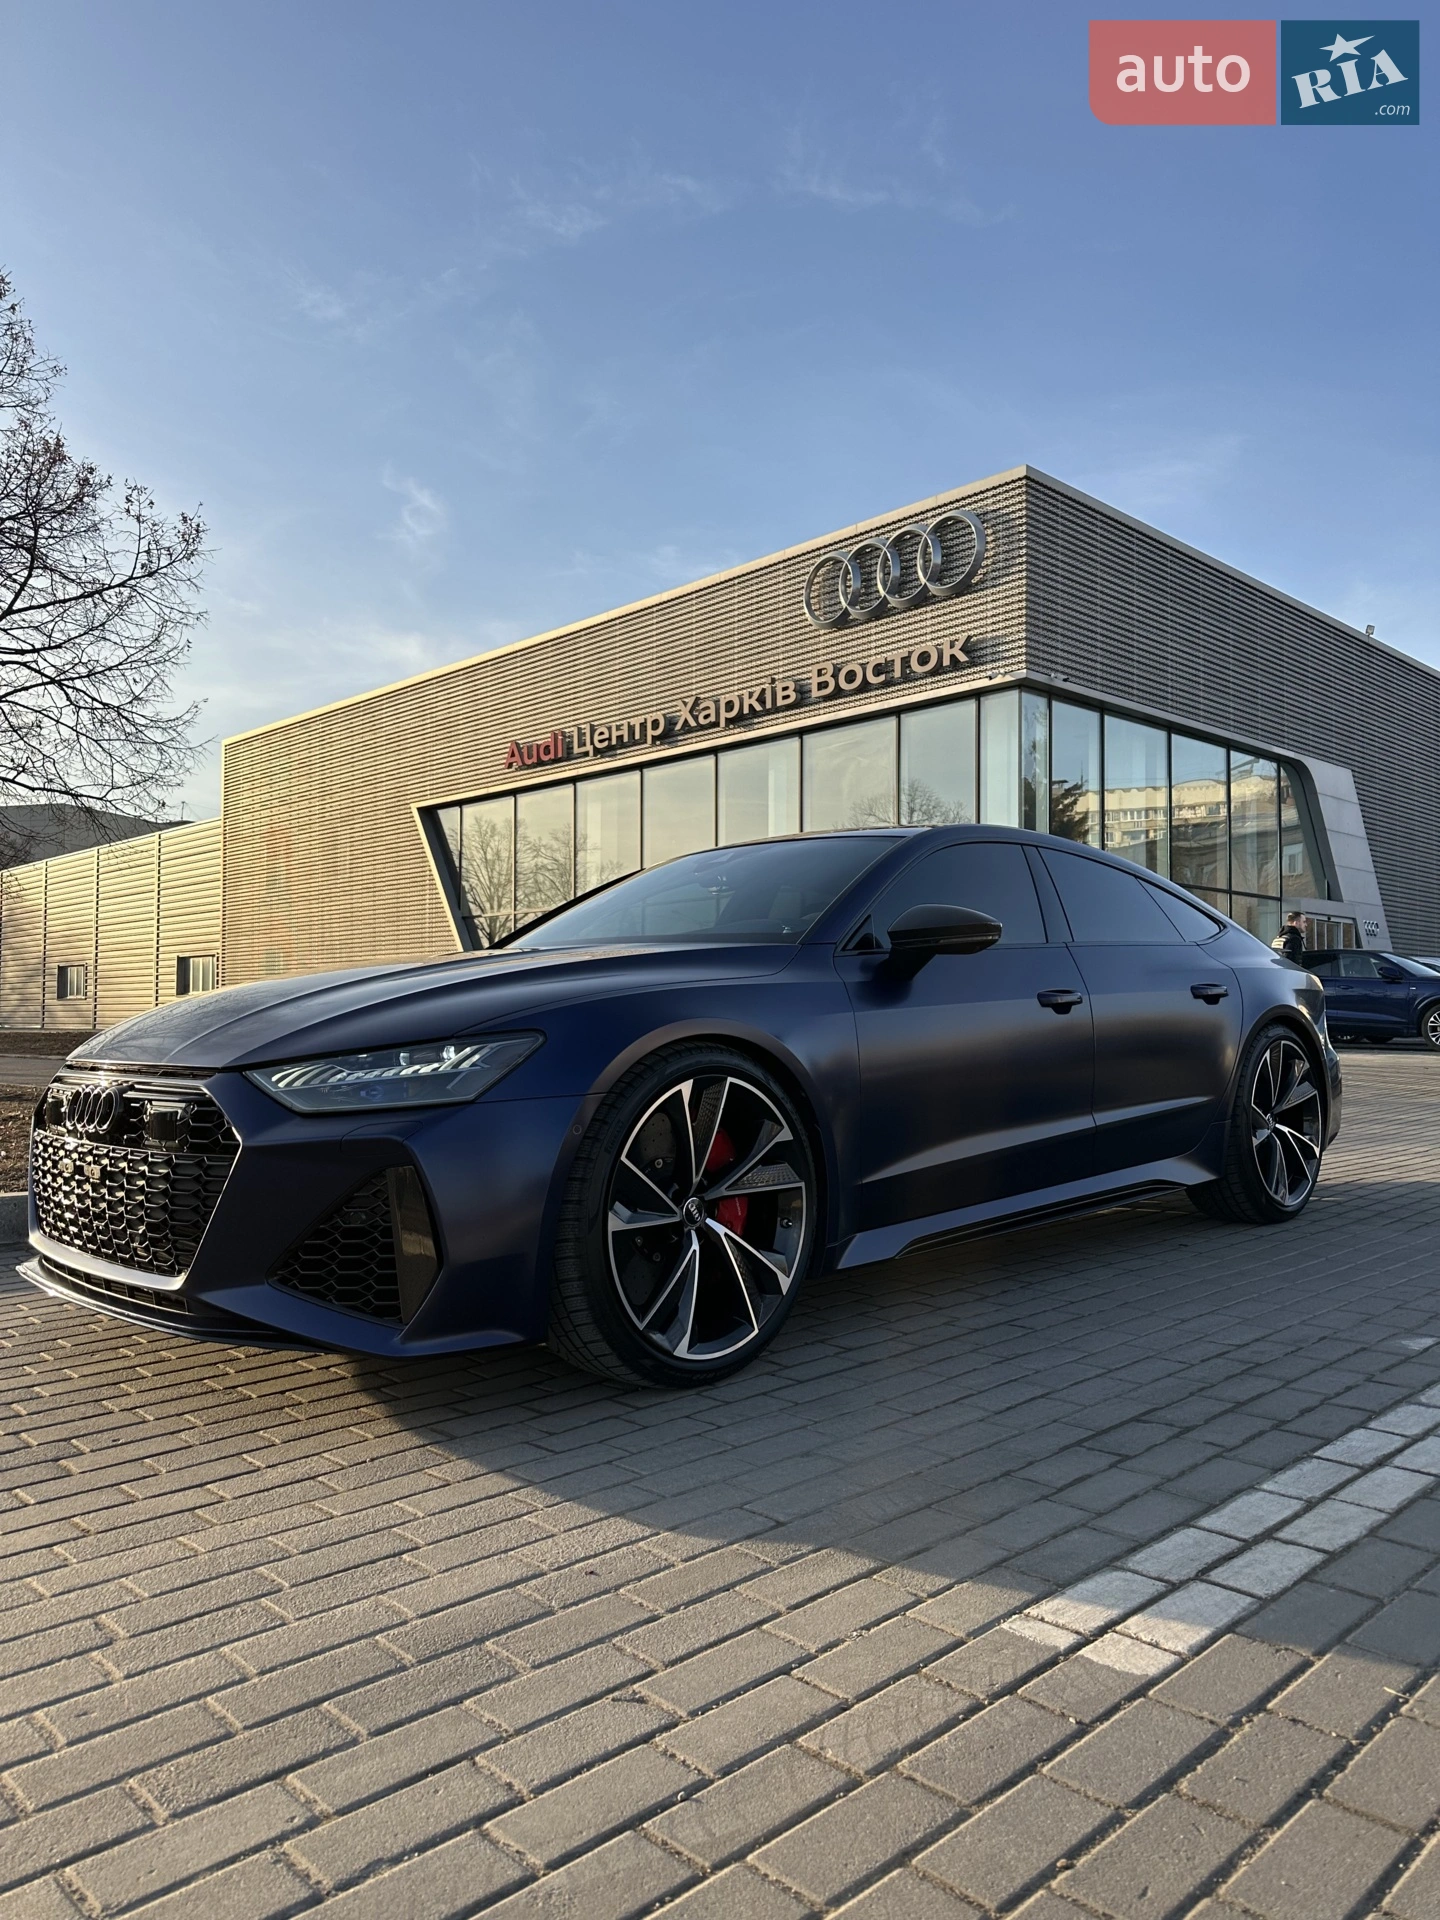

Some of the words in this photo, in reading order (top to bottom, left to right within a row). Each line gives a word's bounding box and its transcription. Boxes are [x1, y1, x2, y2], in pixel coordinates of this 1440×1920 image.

[504, 729, 565, 769] Audi
[573, 712, 666, 757] Центр
[674, 676, 797, 731] Харків
[811, 634, 970, 698] Восток
